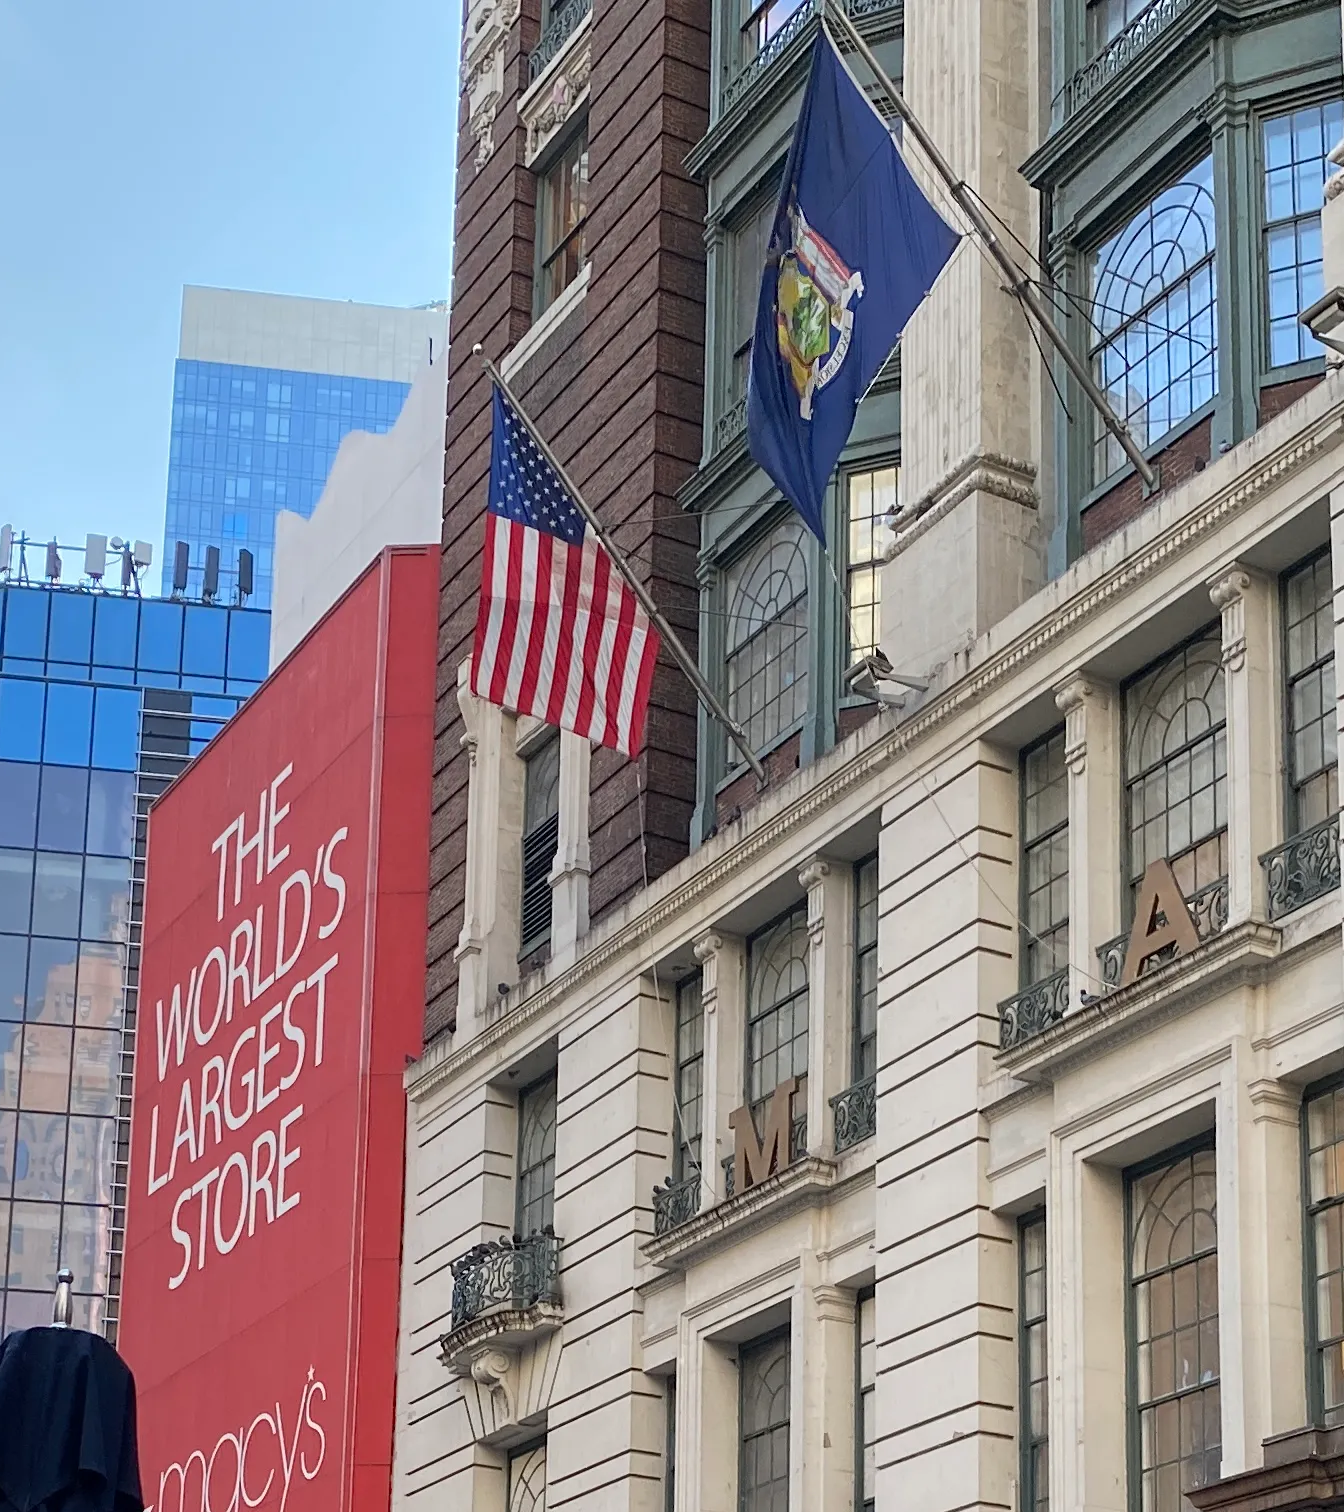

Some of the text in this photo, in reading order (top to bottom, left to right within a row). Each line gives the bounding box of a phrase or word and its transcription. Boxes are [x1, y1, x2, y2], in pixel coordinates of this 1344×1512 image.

[212, 761, 293, 922] THE
[156, 826, 348, 1082] WORLD'S
[147, 953, 339, 1196] LARGEST
[169, 1104, 304, 1290] STORE
